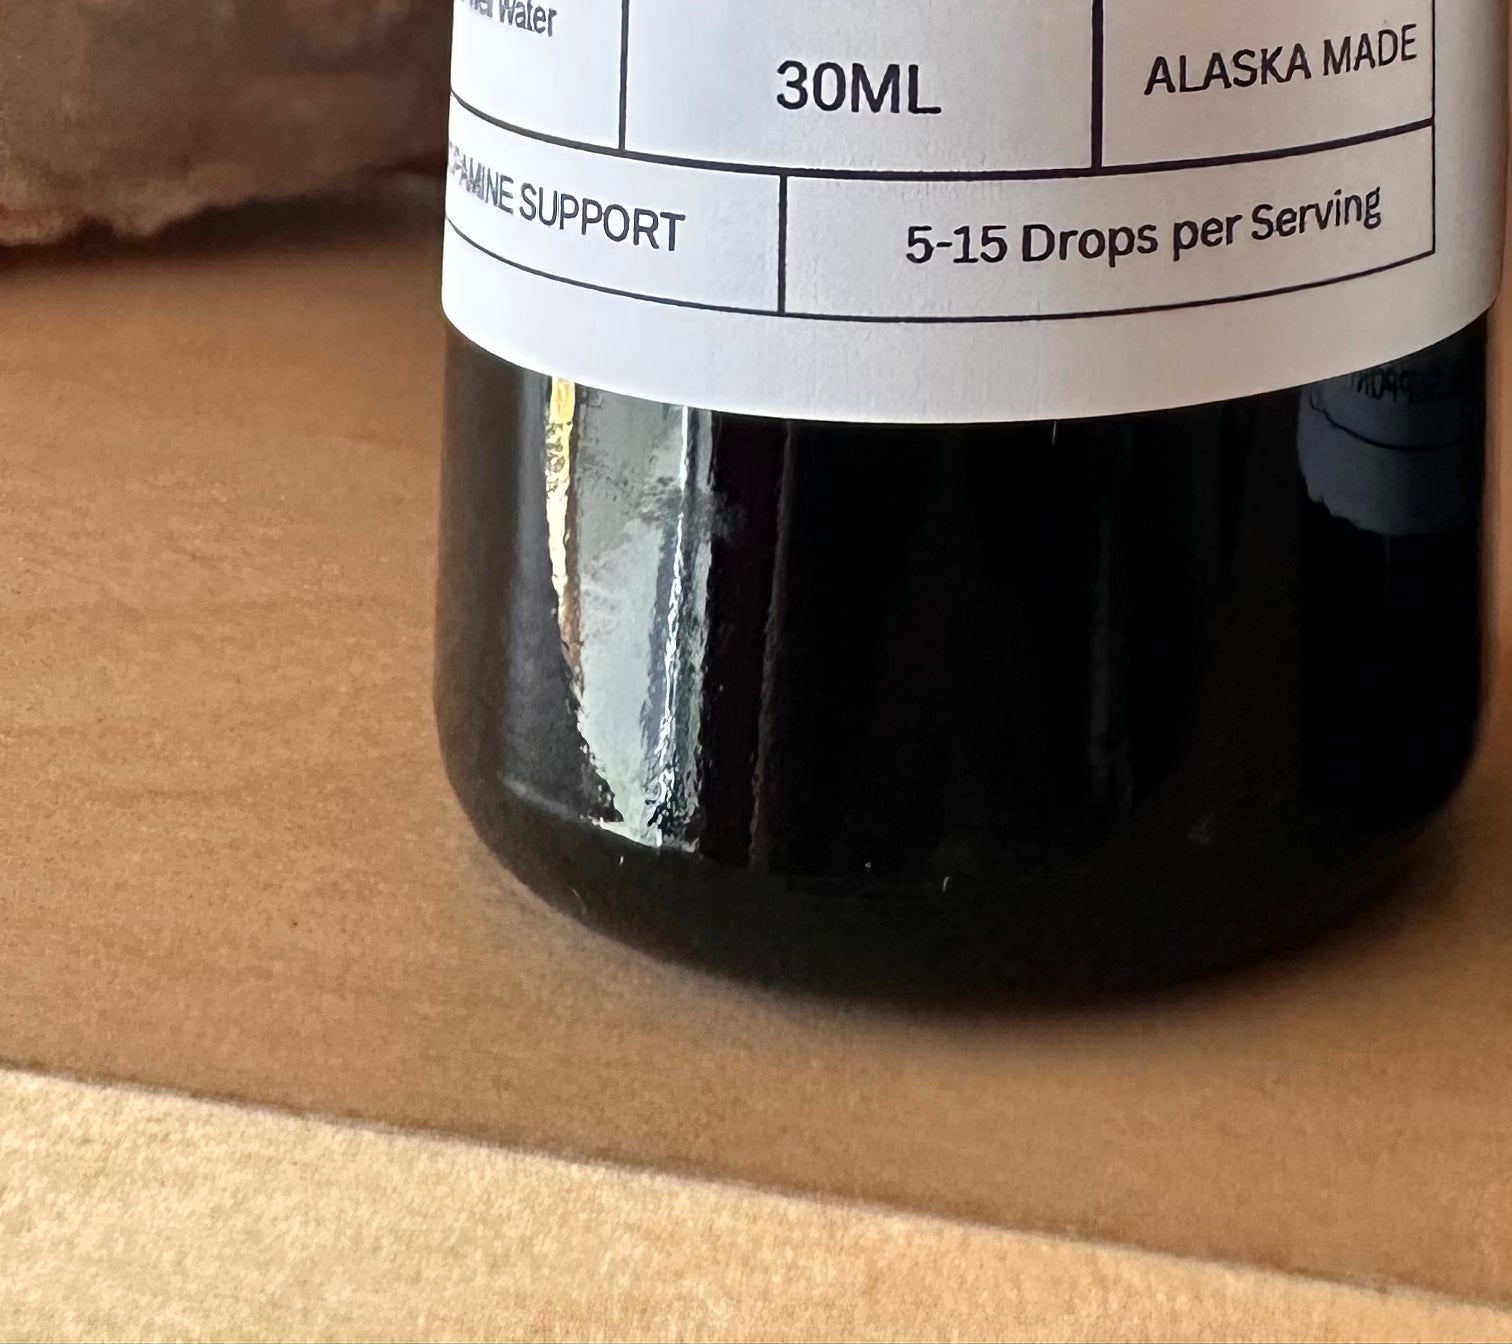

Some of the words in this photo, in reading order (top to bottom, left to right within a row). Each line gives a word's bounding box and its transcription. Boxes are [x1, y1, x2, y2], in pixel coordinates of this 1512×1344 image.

[776, 59, 943, 115] 30ML
[1143, 42, 1313, 97] ALASKA
[1322, 23, 1418, 77] MADE
[518, 182, 687, 252] SUPPORT
[905, 224, 1009, 265] 5-15
[1021, 223, 1159, 269] Drops
[1172, 214, 1244, 263] per
[1250, 186, 1382, 241] Serving
